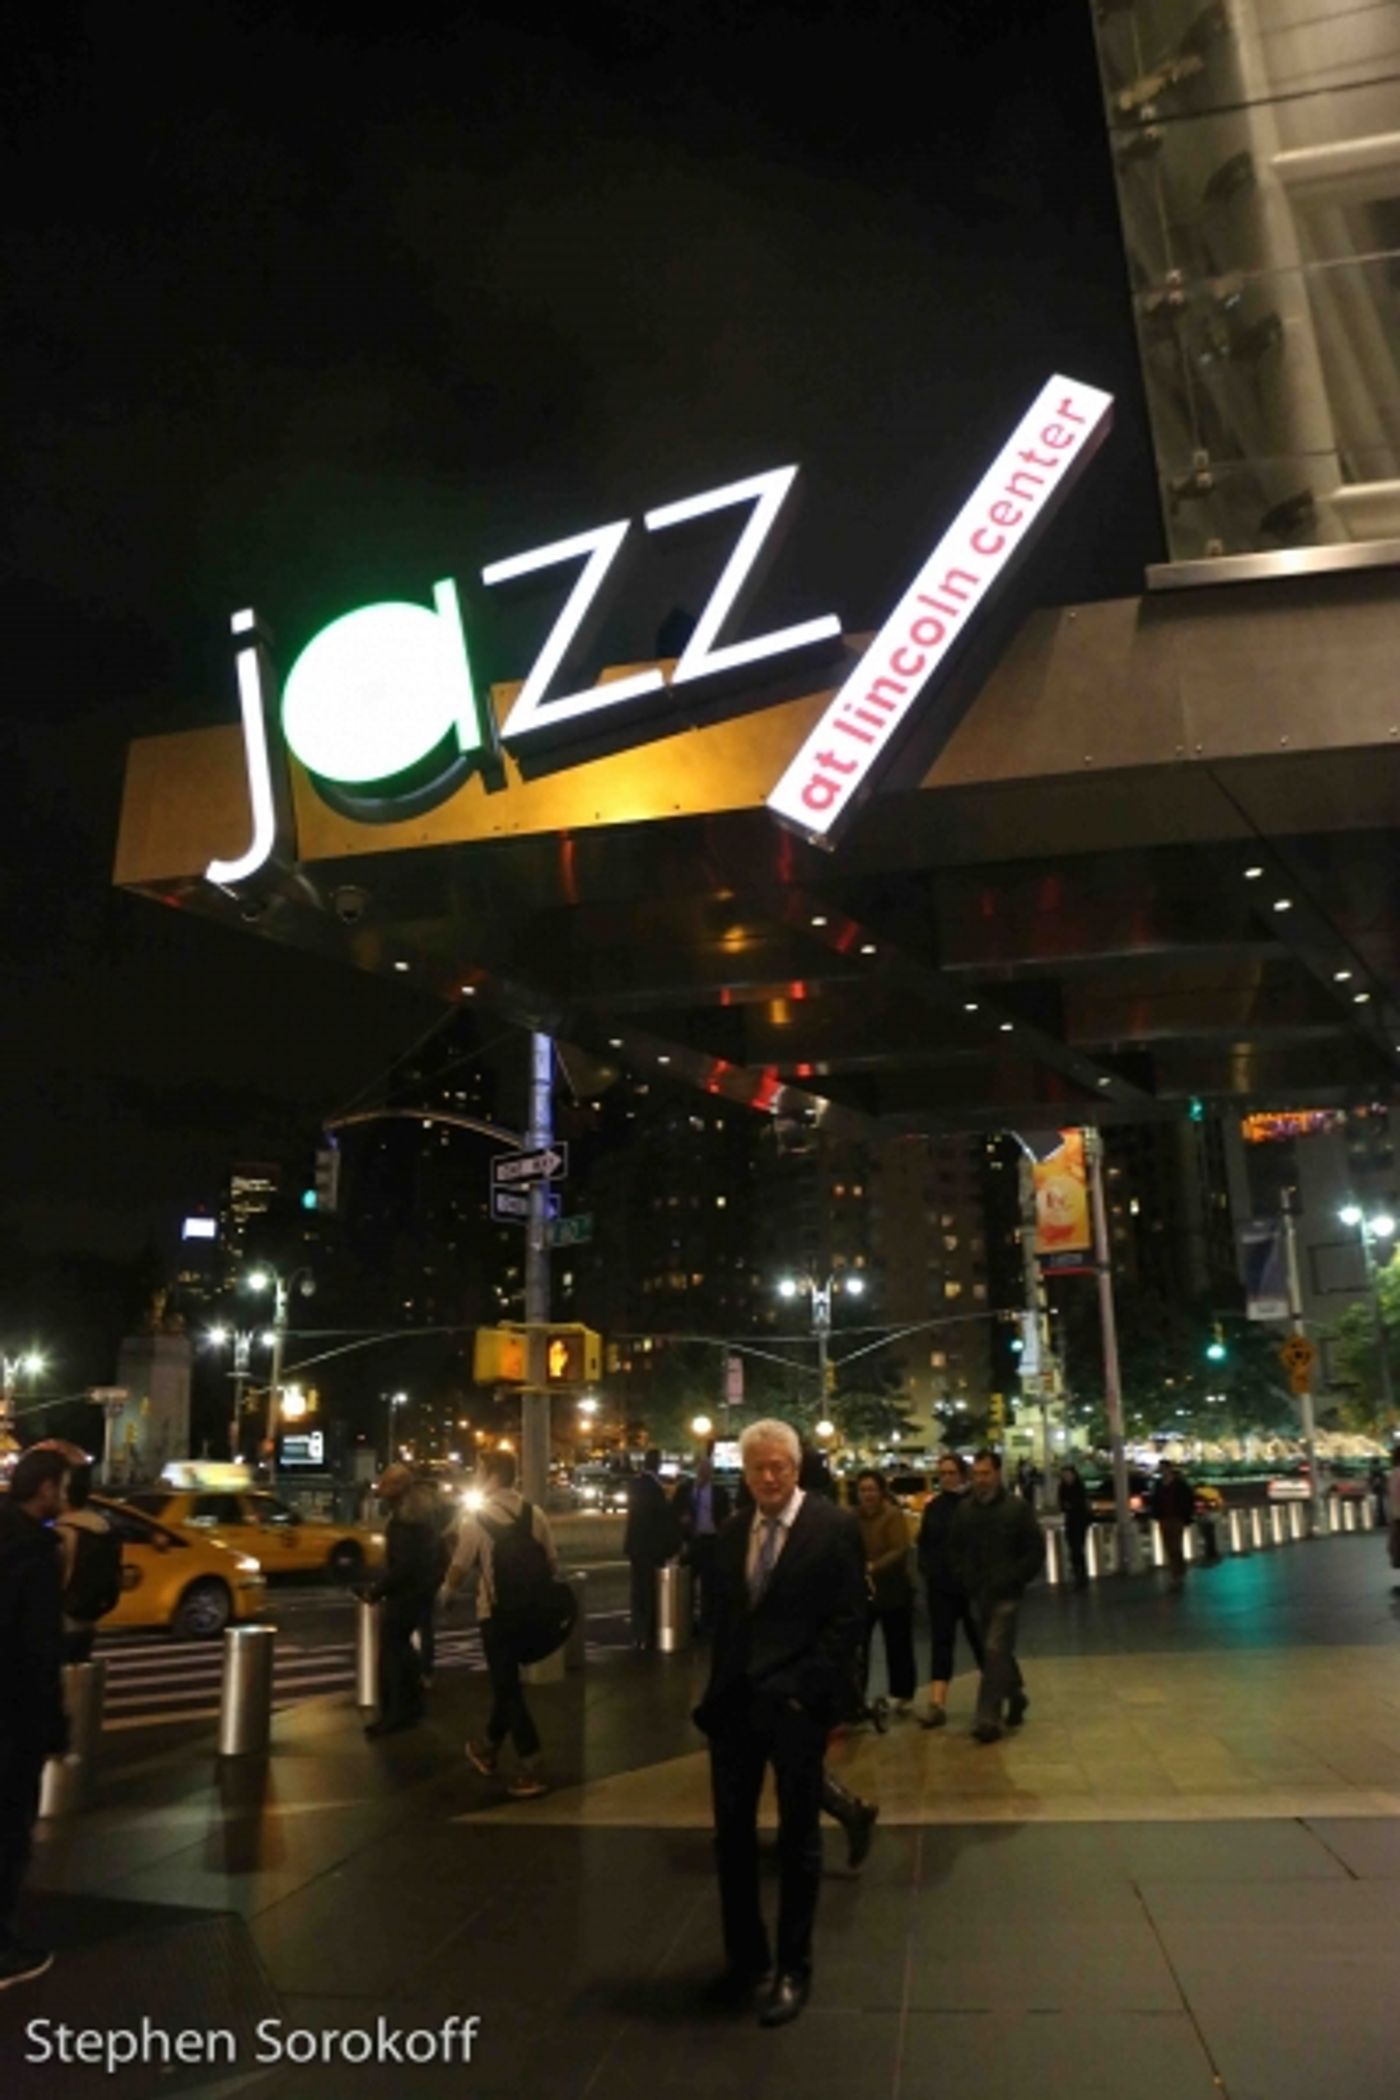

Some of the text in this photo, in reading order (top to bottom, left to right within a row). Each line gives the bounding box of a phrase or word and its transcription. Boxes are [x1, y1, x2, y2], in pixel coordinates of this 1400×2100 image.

[205, 465, 842, 885] jazz
[800, 396, 1088, 812] at lincoln center
